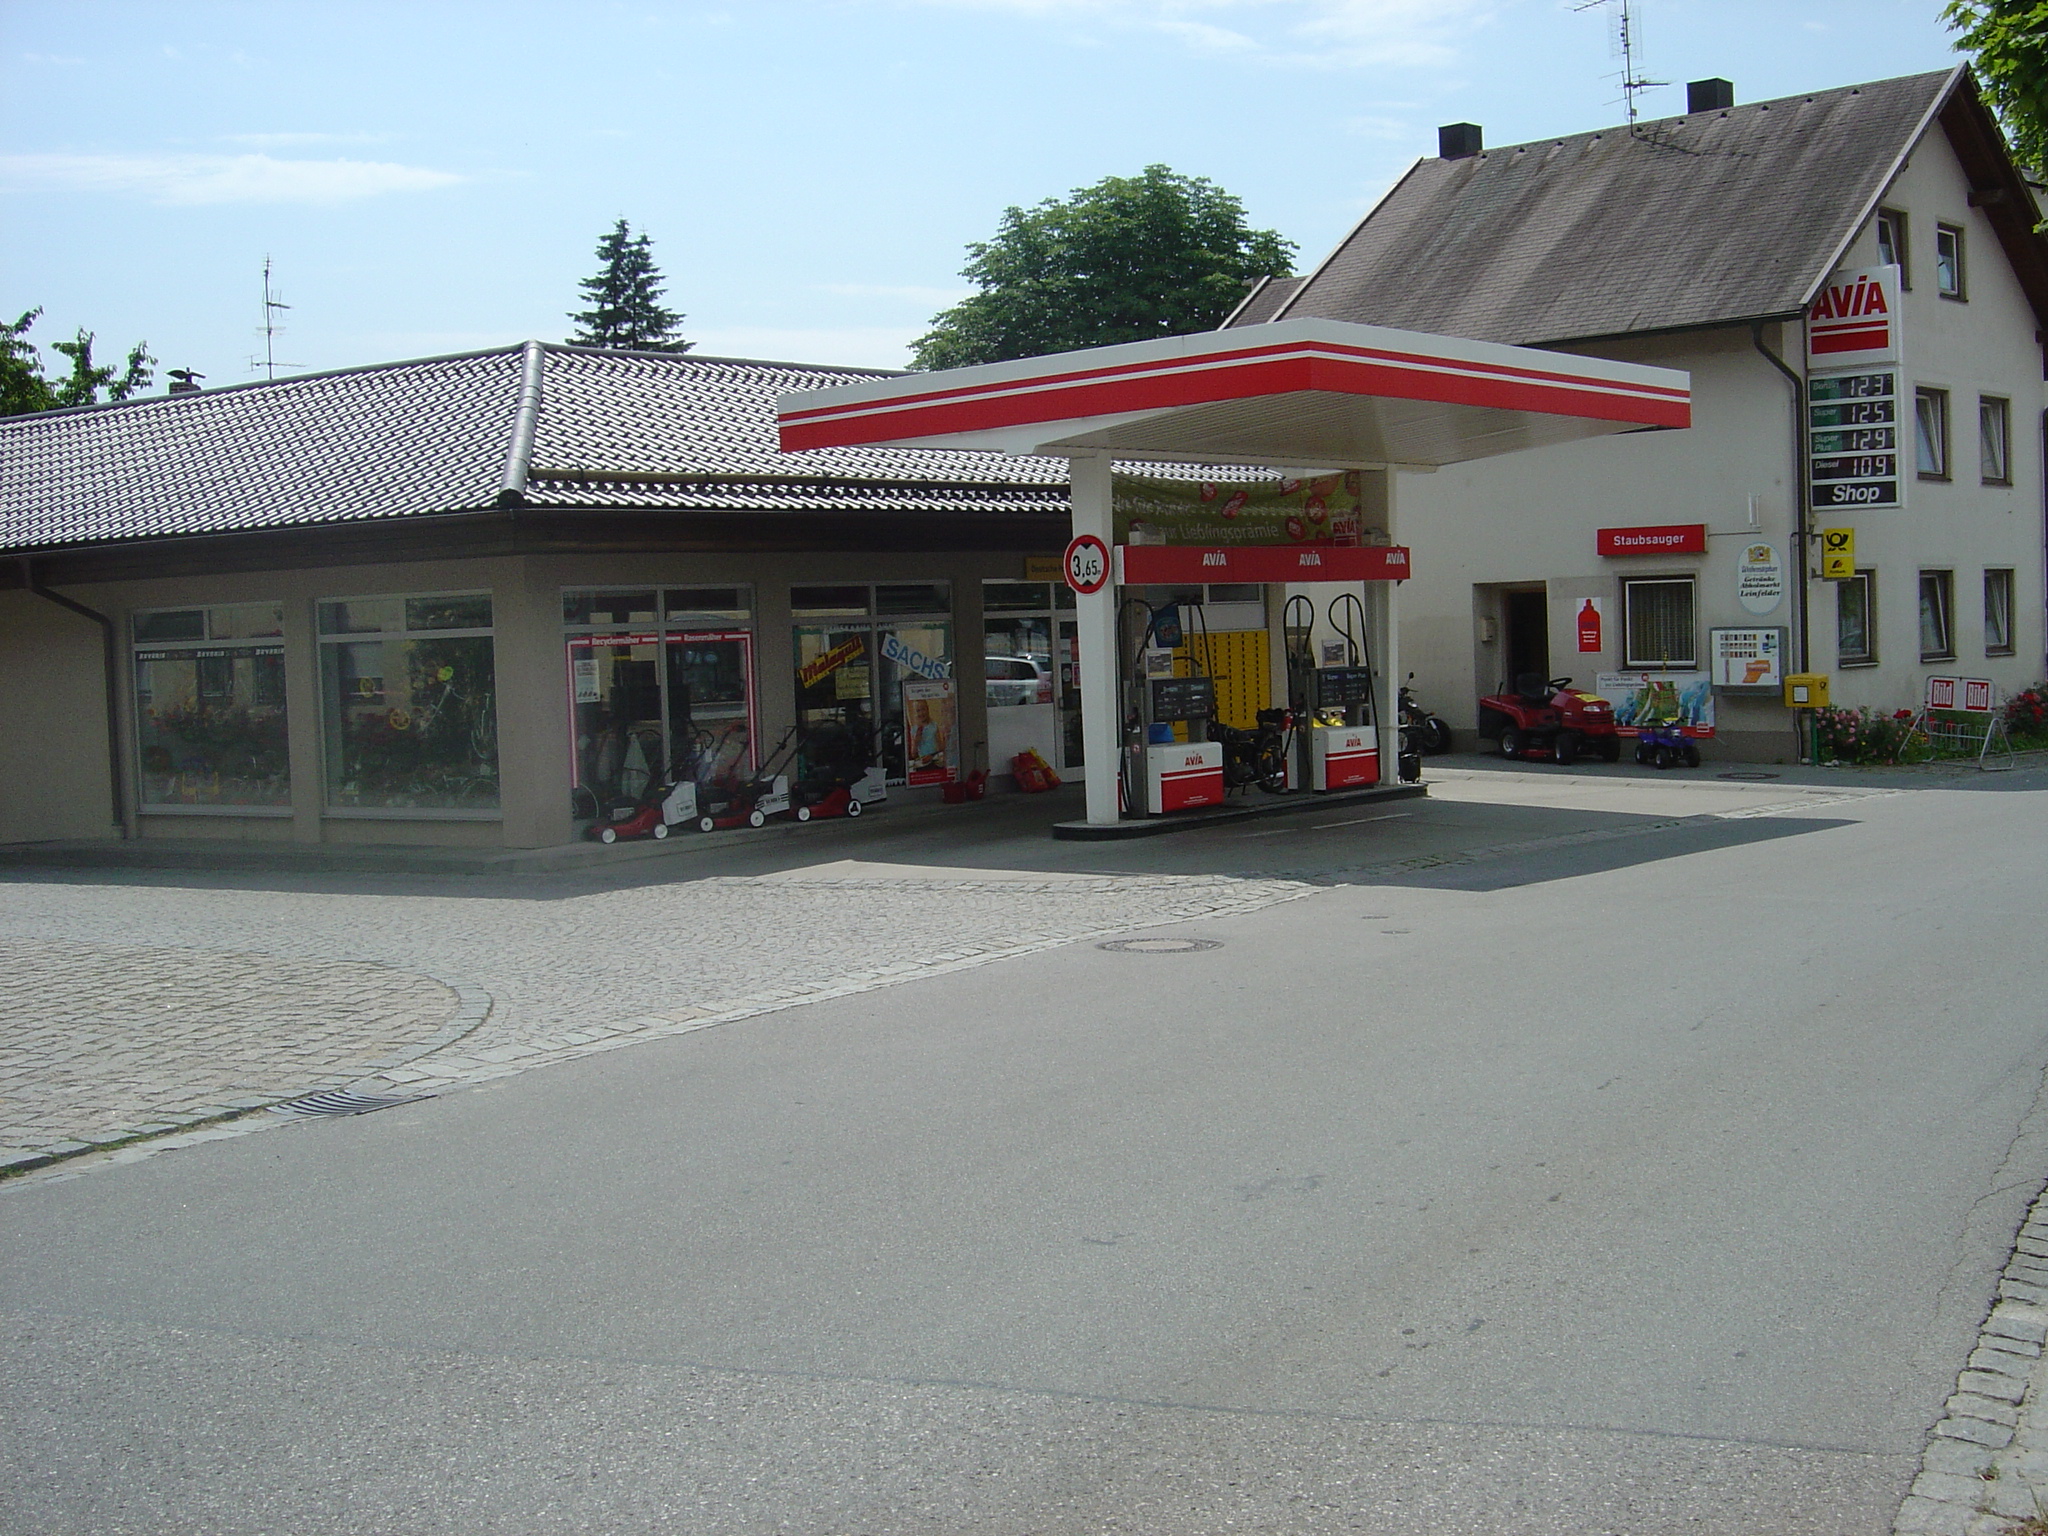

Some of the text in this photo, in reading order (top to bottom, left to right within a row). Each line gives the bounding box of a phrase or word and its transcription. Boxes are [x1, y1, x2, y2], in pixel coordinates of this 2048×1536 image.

[1811, 275, 1887, 320] AVIA
[1851, 376, 1884, 396] 123
[1814, 408, 1837, 417] Super
[1852, 403, 1885, 423] 125
[1815, 434, 1839, 443] Super
[1853, 429, 1886, 449] 129
[1815, 443, 1832, 452] Plus
[1815, 460, 1839, 469] Diesel
[1832, 485, 1880, 502] Shop
[1180, 523, 1279, 543] Lieblingsprämie
[1614, 535, 1685, 546] Staubsauger
[1203, 550, 1227, 566] AVIA
[1299, 550, 1321, 566] AVIA
[1385, 550, 1406, 565] AVIA
[1073, 555, 1097, 578] 3,65
[1740, 589, 1781, 598] Leinfelder
[886, 638, 945, 679] SACHS
[1933, 682, 1952, 705] Bild
[1967, 684, 1987, 707] Bild
[1346, 736, 1362, 748] AVIA
[1185, 753, 1203, 766] AVIA
